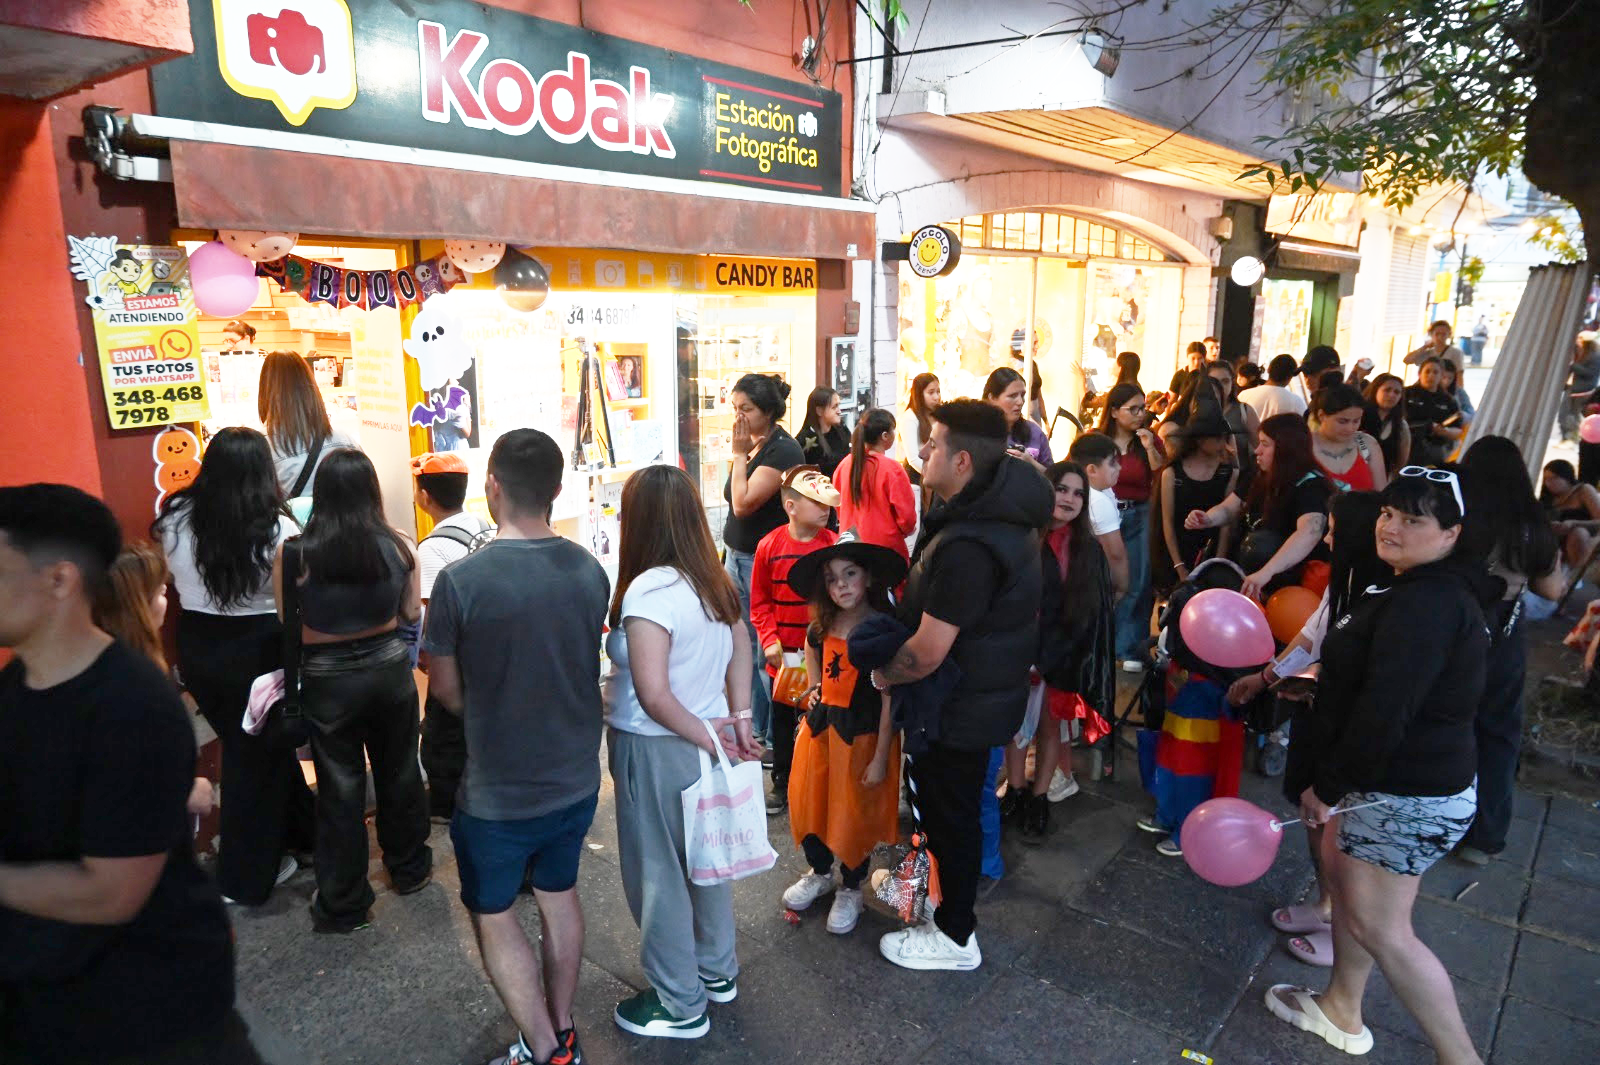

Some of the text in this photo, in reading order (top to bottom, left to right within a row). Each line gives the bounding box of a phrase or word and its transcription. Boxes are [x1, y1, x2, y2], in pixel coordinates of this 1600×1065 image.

[418, 20, 676, 159] Kodak
[716, 92, 795, 134] Estación
[716, 125, 818, 173] Fotográfica
[913, 229, 949, 254] PICCOLO
[317, 264, 416, 304] BOOO
[716, 262, 814, 288] CANDY BAR
[127, 297, 176, 309] ESTAMOS
[109, 312, 184, 323] ATENDIENDO
[113, 345, 154, 363] ENVIÁ
[113, 362, 194, 376] TUS FOTOS
[115, 373, 195, 385] POR WHATSAPP
[113, 385, 203, 406] 348-468
[116, 406, 170, 425] 7978
